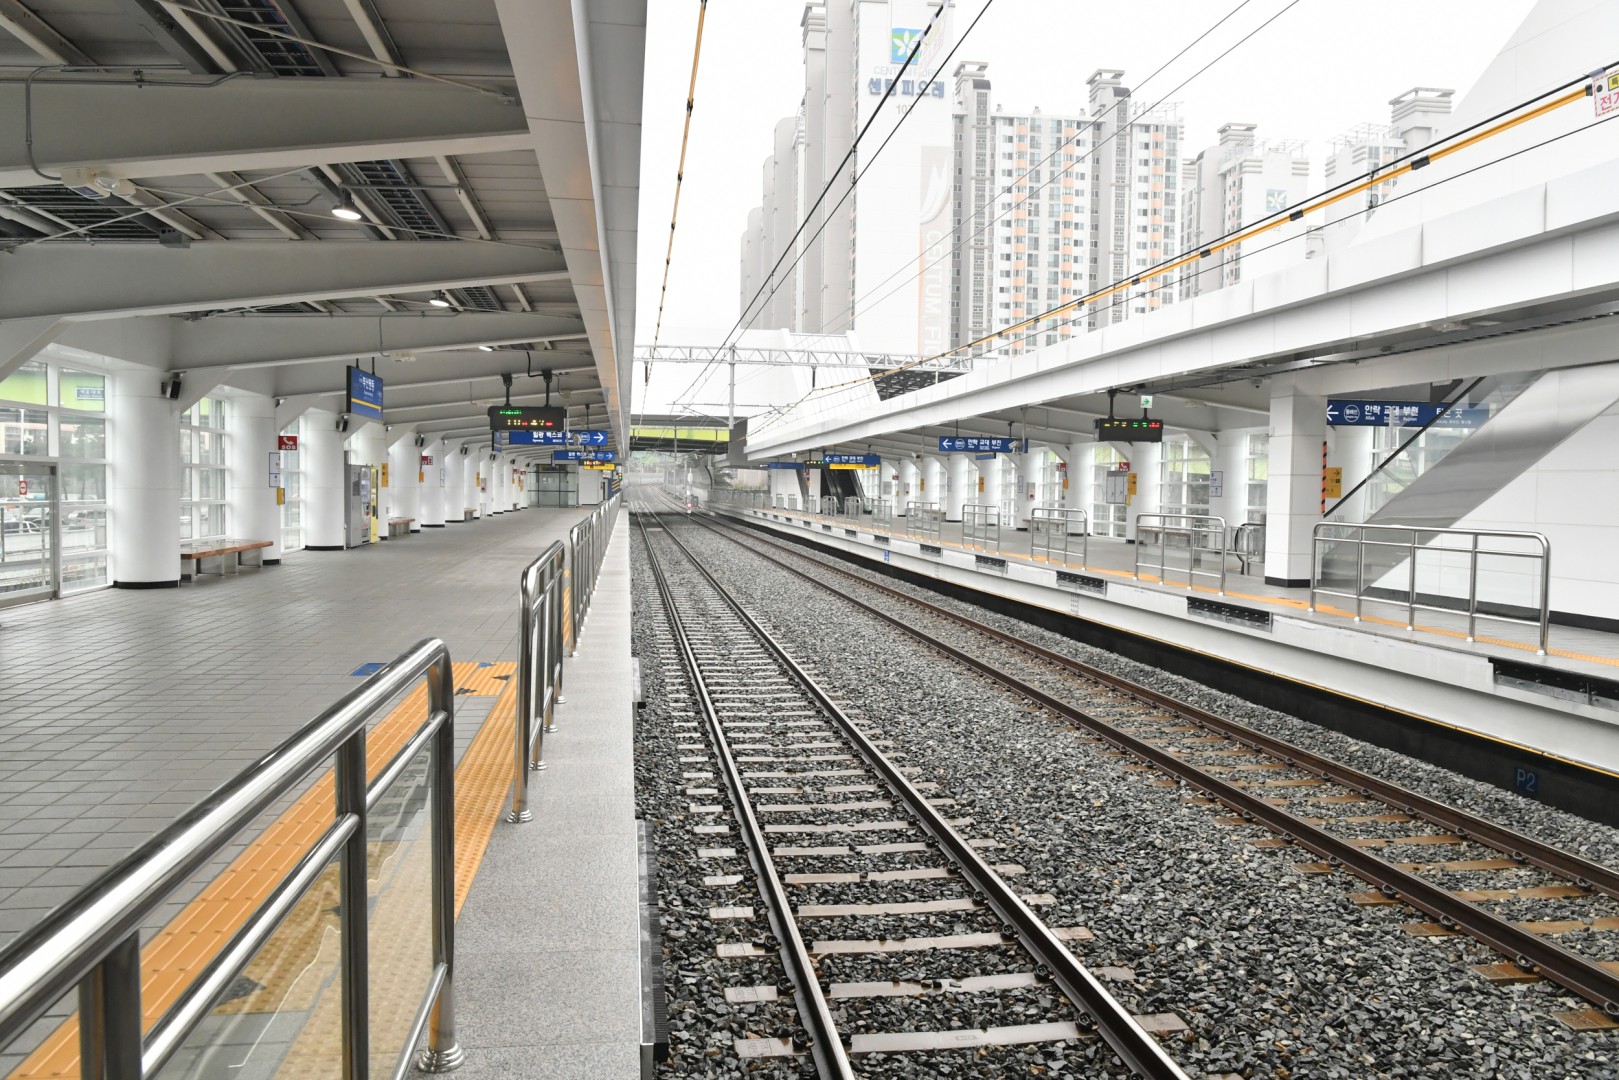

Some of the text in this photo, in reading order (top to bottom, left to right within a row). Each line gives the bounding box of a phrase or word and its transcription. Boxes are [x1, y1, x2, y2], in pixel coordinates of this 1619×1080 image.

[873, 66, 912, 76] CENTM
[925, 230, 943, 315] CENTUM
[1364, 405, 1381, 415] 안락
[1403, 406, 1418, 417] 부전
[1516, 768, 1536, 792] P2
